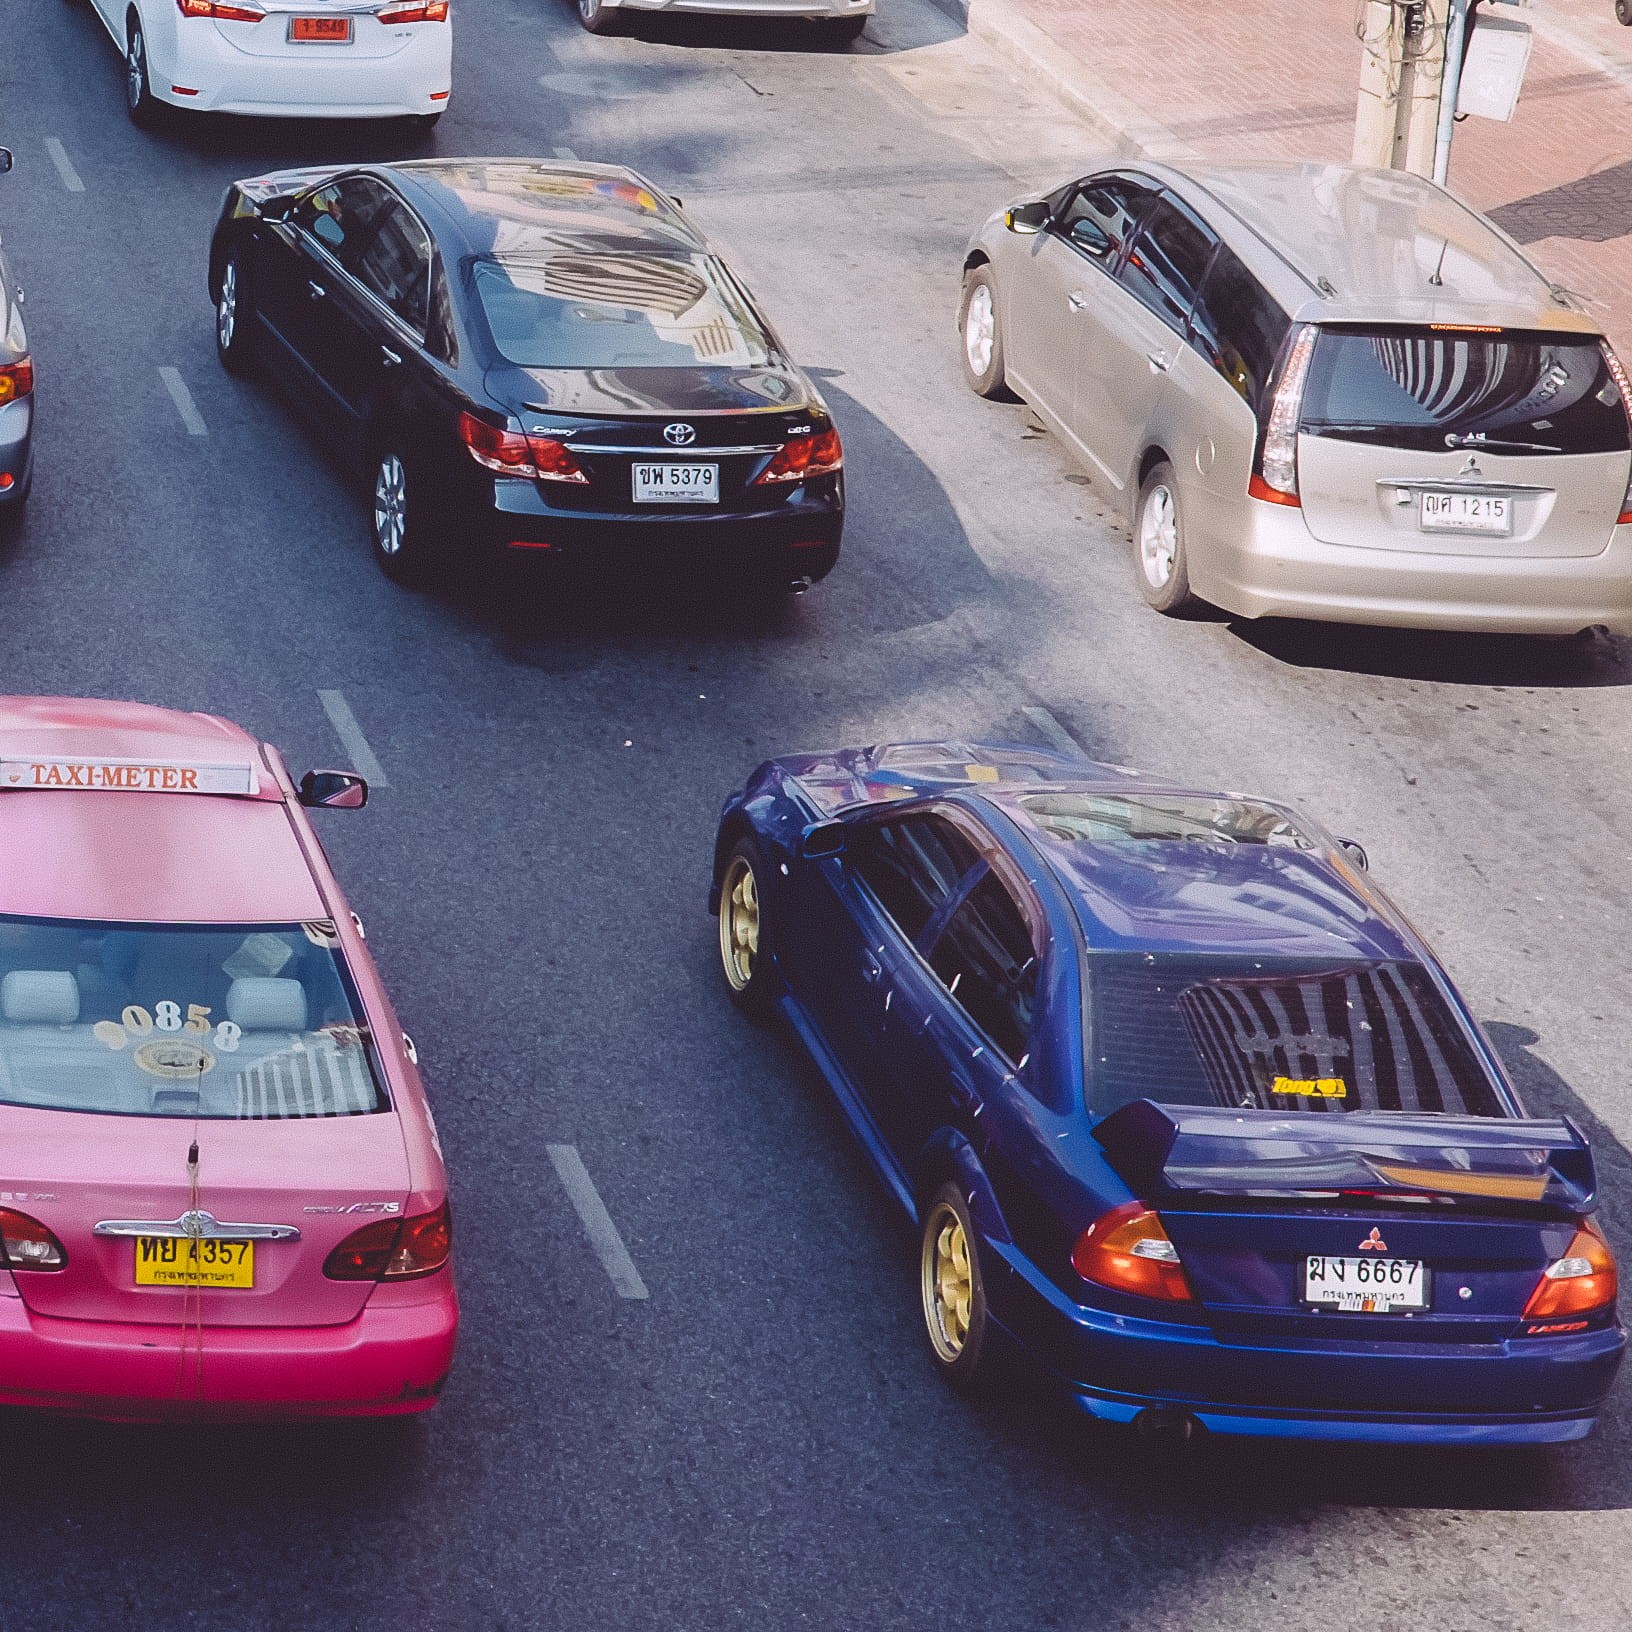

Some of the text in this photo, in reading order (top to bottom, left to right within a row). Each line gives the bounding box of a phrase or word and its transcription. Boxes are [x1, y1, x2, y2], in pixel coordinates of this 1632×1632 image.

[670, 467, 712, 485] 5379
[1462, 499, 1506, 517] 1215
[30, 763, 200, 790] TAXI-METER
[1356, 1257, 1422, 1286] 6667
